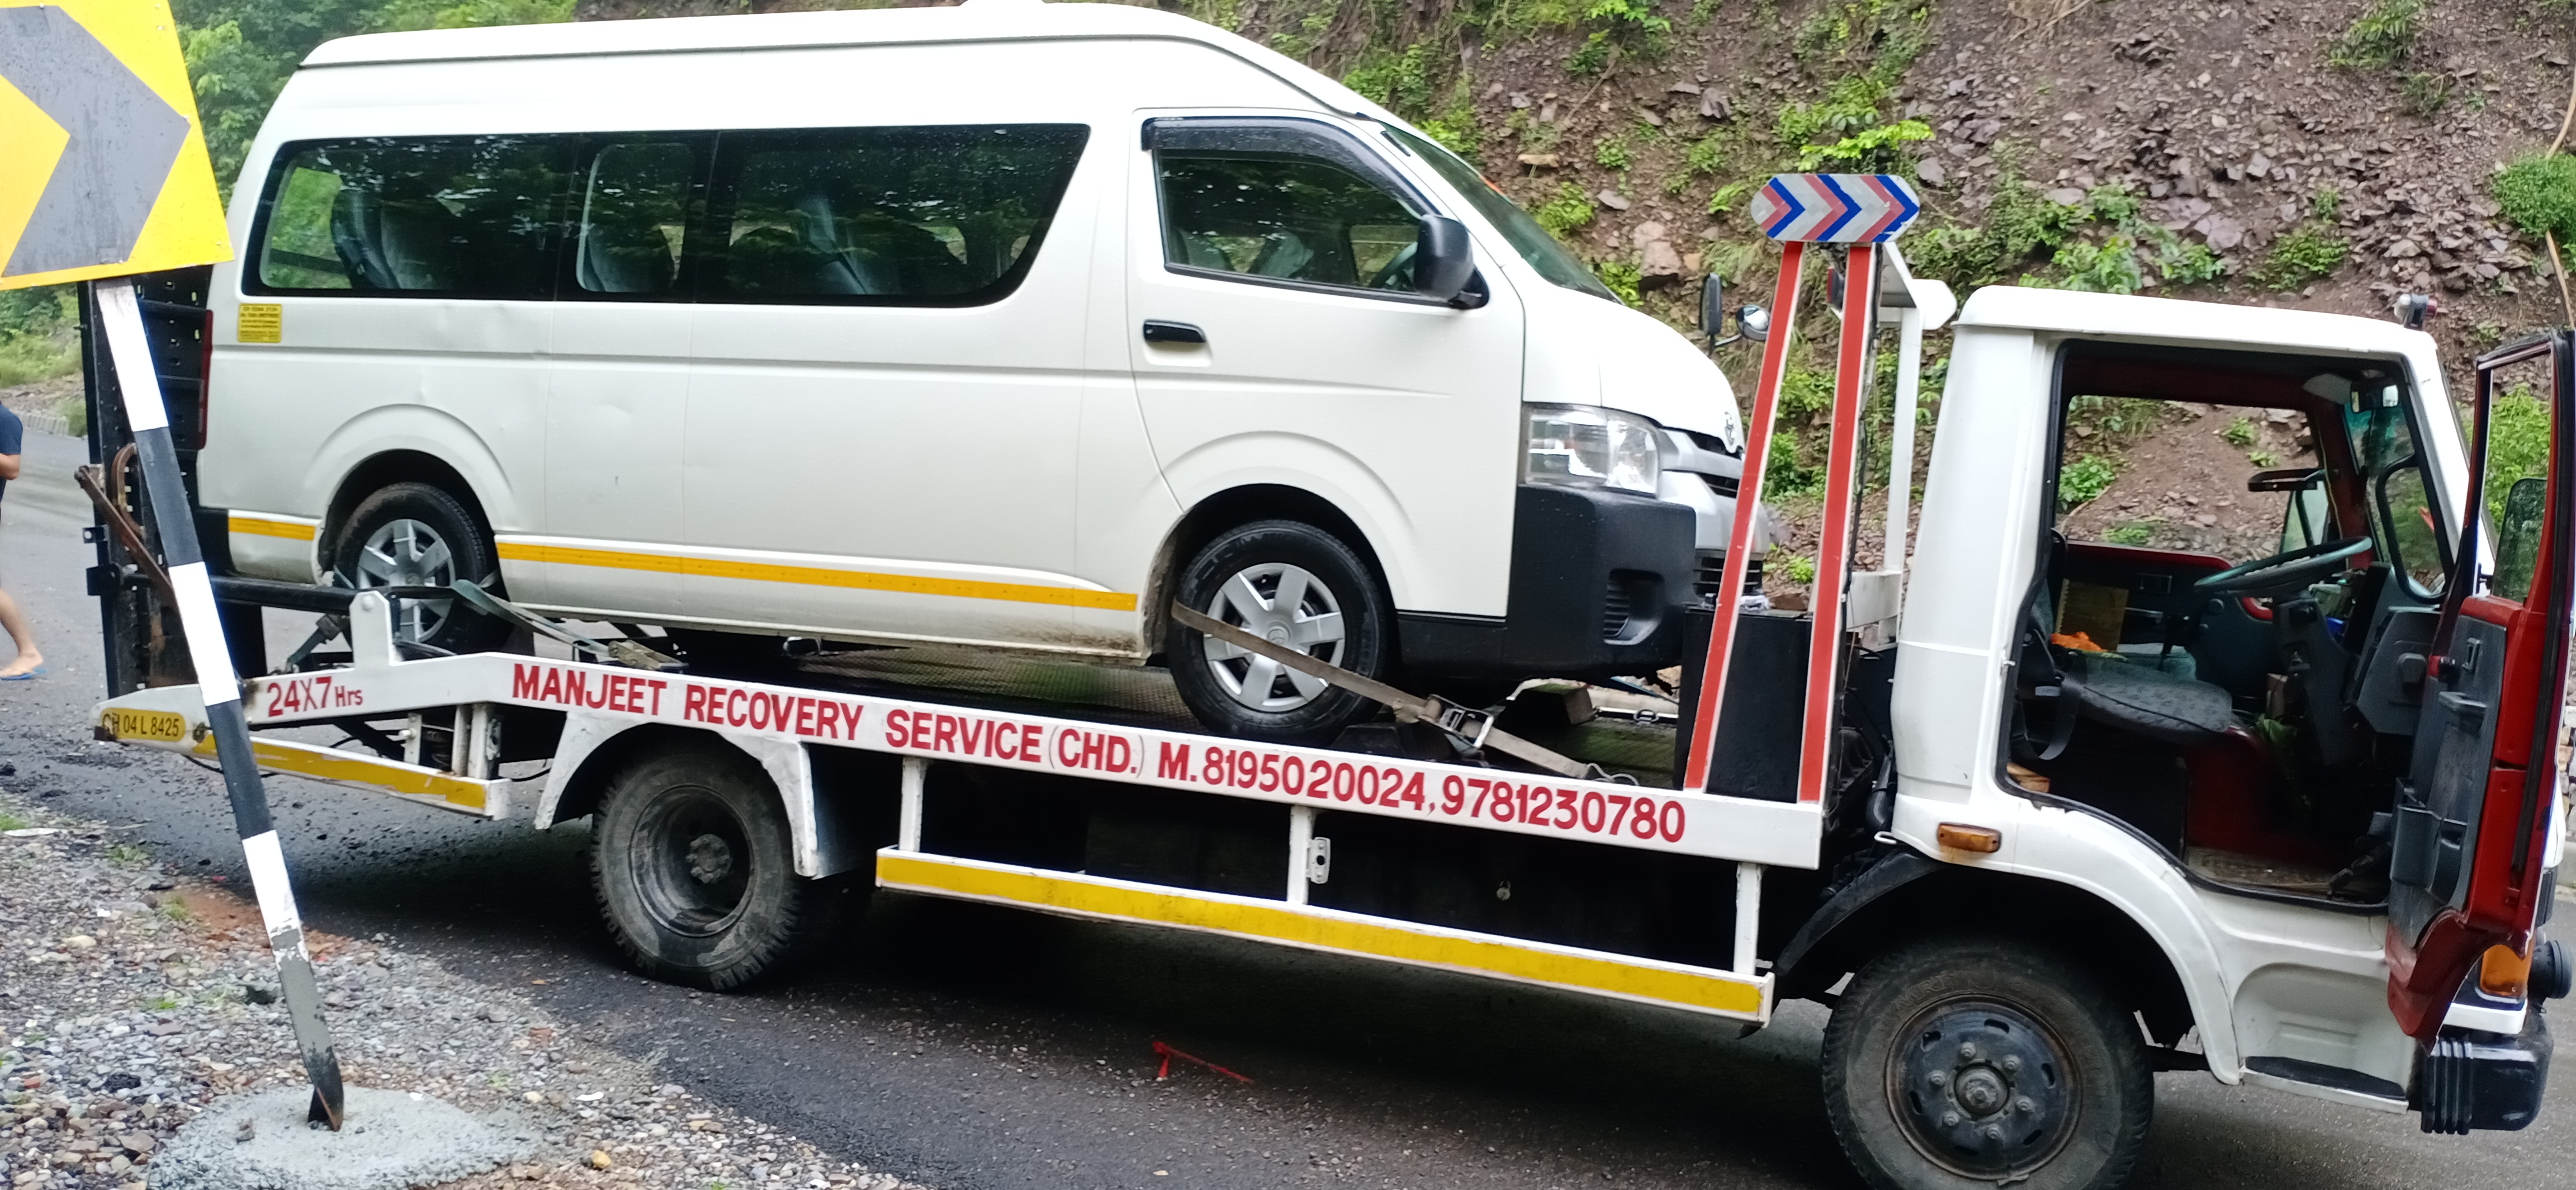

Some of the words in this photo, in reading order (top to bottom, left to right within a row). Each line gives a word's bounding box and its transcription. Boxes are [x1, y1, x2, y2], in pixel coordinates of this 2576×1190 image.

[267, 676, 332, 717] 24X7
[335, 685, 363, 707] Hrs
[513, 663, 667, 716] MANJEET
[684, 684, 864, 740] RECOVERY
[886, 709, 1043, 763] SERVICE
[124, 714, 138, 734] 04
[140, 715, 148, 735] L
[150, 716, 180, 737] 8425
